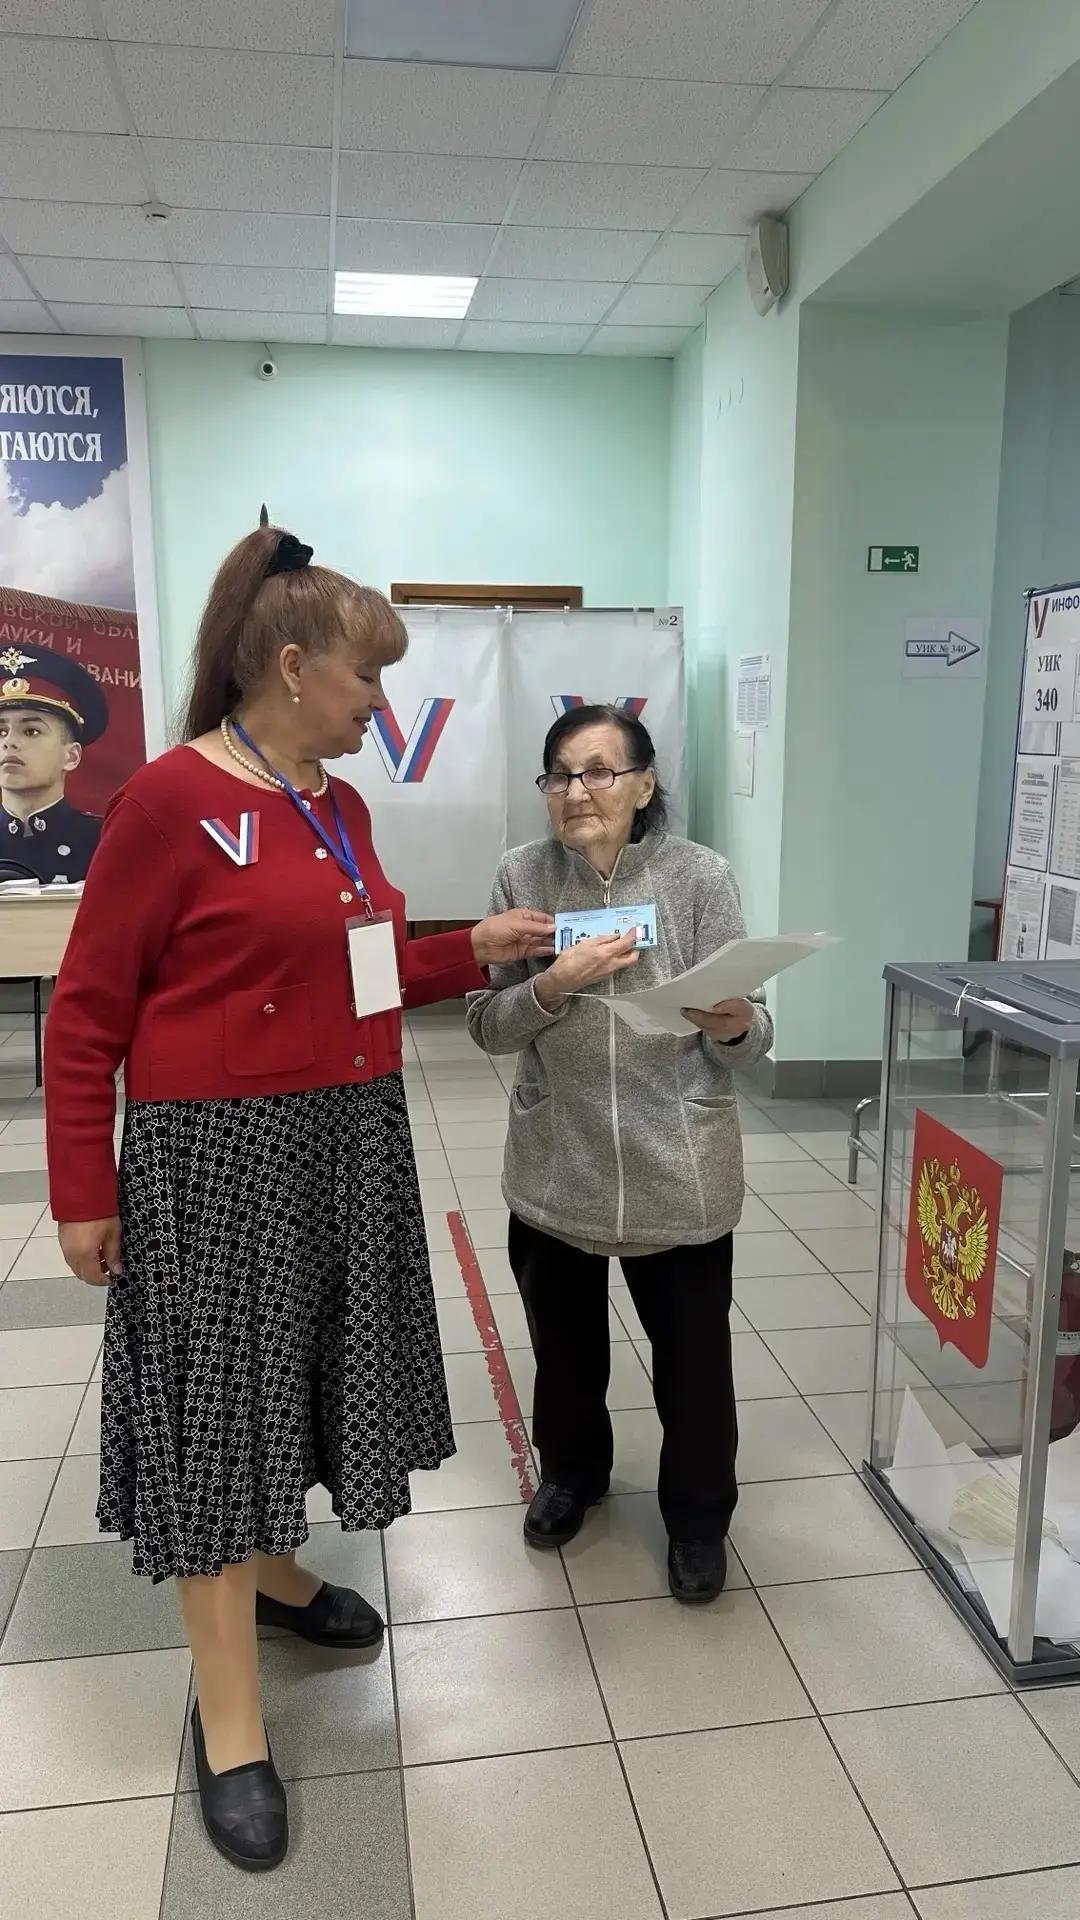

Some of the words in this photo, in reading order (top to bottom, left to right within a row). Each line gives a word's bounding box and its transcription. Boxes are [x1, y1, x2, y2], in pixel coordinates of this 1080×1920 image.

[0, 384, 99, 418] ЯЮТСЯ,
[0, 431, 103, 463] ТАЮТСЯ
[1051, 594, 1080, 613] ИНФО
[92, 618, 140, 640] ОБЛ
[915, 643, 937, 653] УИК
[950, 643, 967, 655] 340
[1037, 654, 1062, 672] УИК
[78, 662, 142, 689] ВАНИ
[1034, 687, 1059, 712] 340
